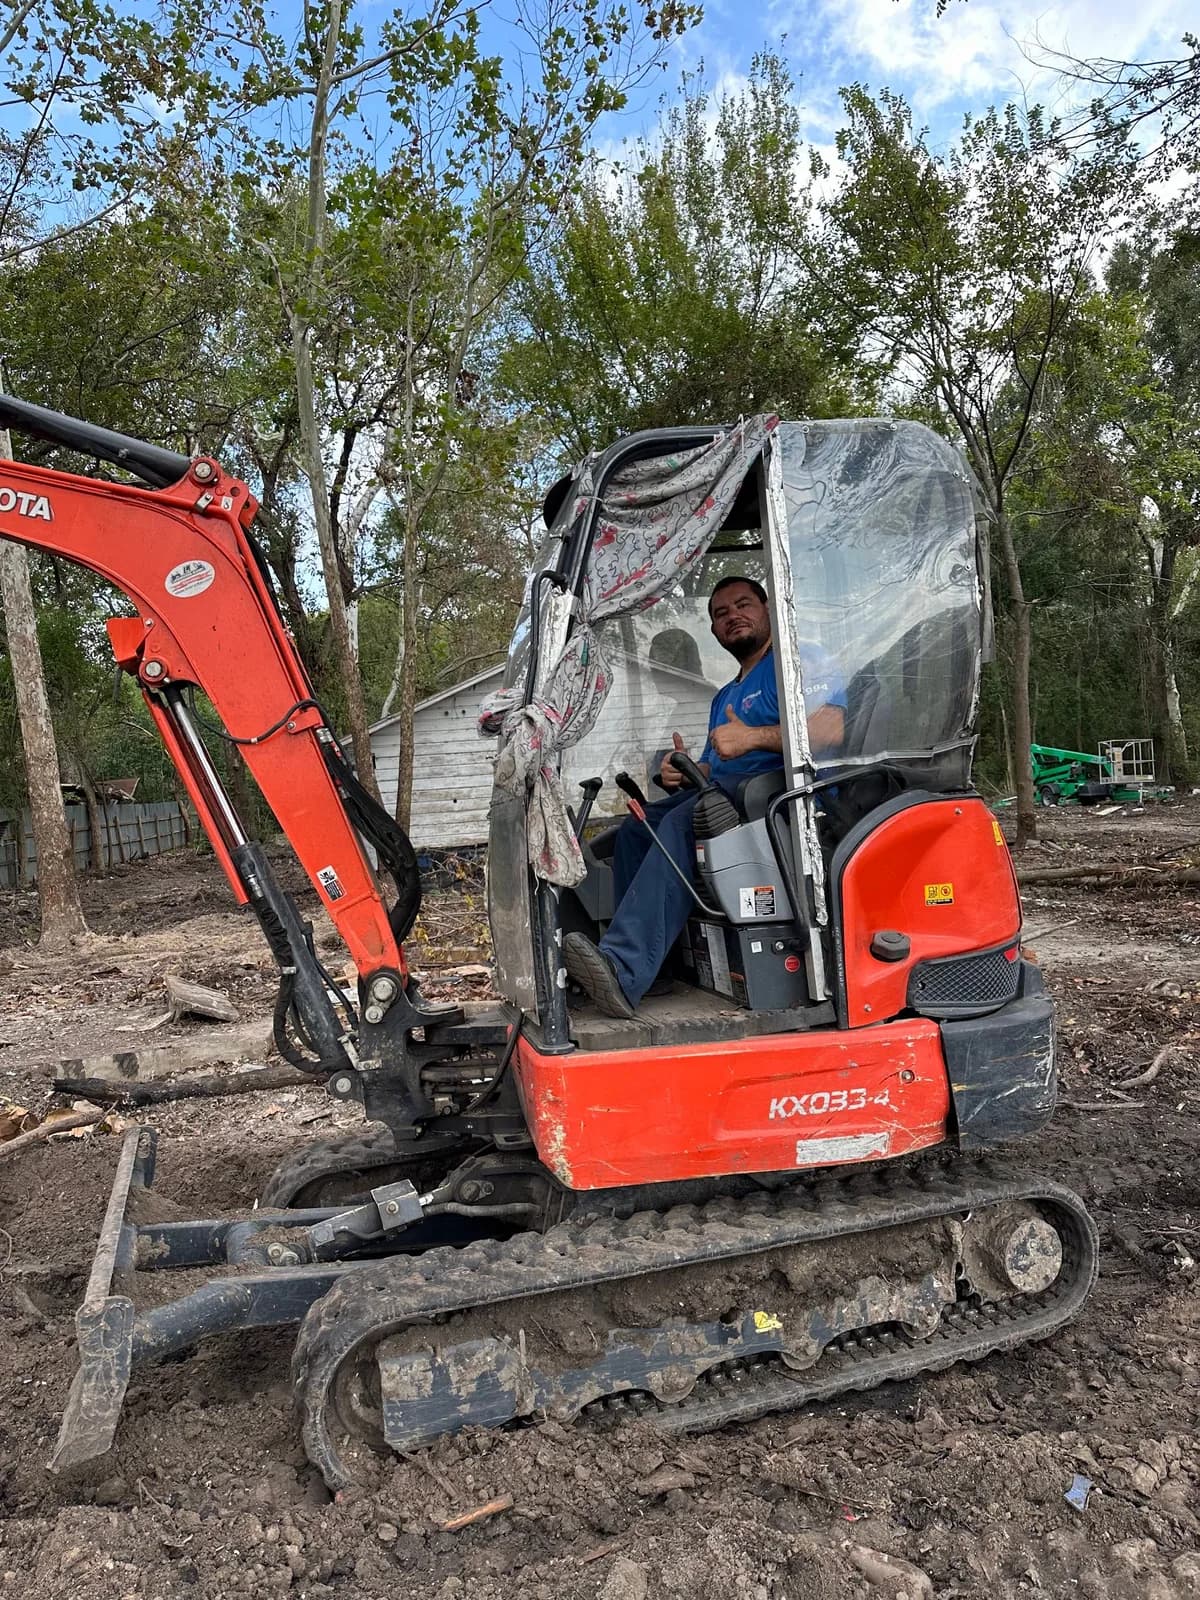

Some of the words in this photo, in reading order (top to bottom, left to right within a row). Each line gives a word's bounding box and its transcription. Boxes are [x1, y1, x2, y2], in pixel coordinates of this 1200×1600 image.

[0, 487, 52, 521] OTA
[803, 683, 828, 696] 994
[768, 1087, 890, 1120] KX033-4
